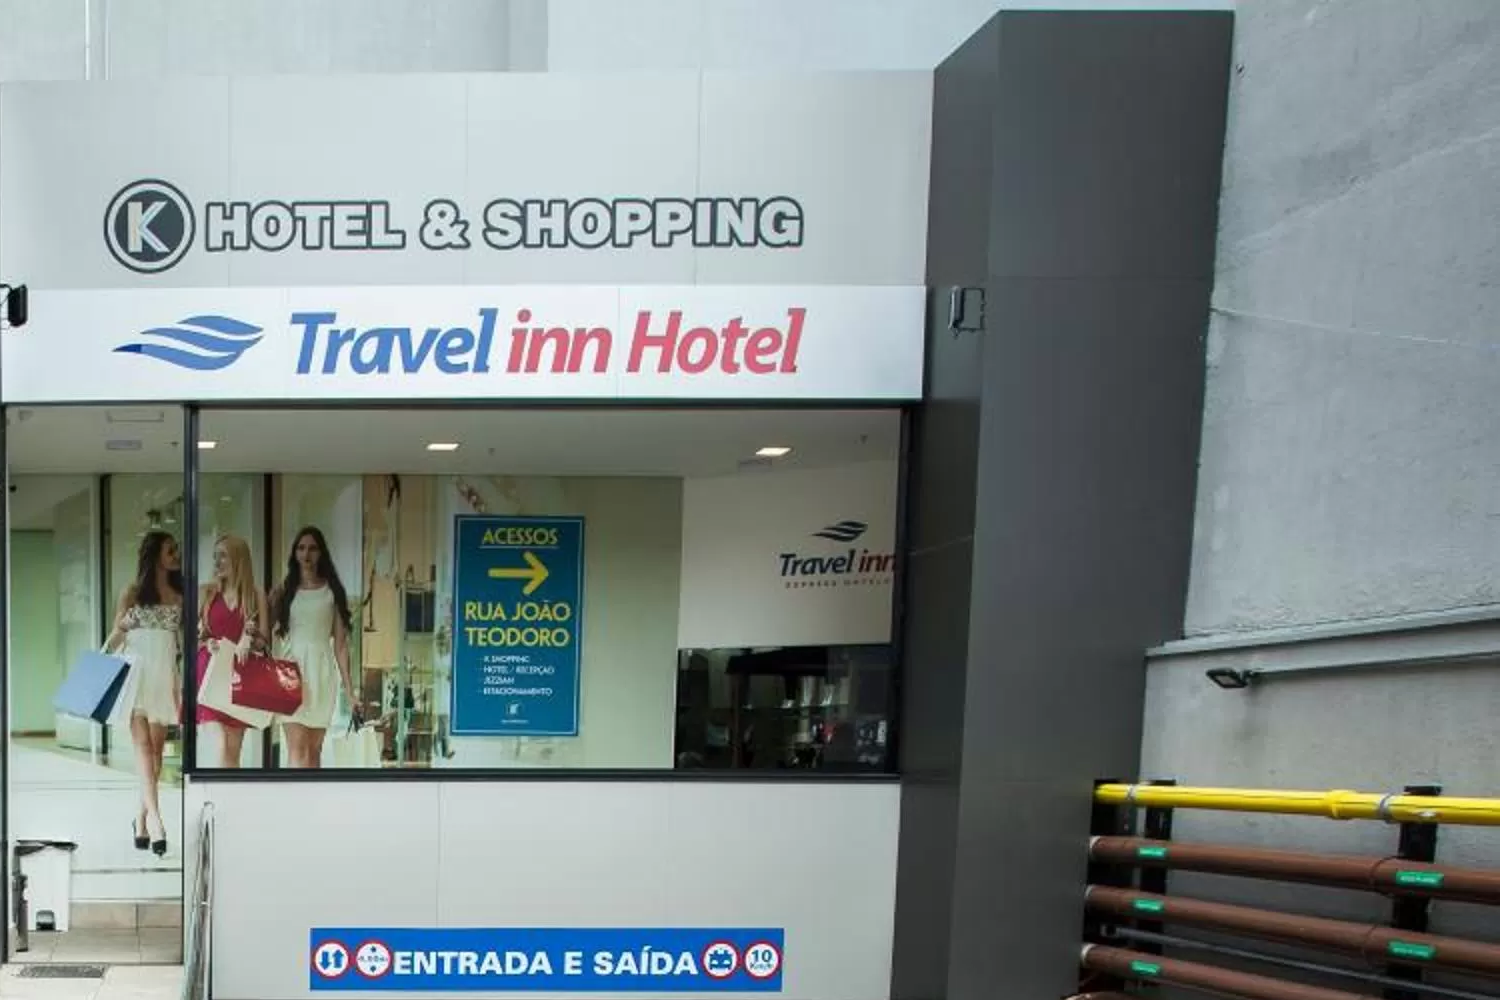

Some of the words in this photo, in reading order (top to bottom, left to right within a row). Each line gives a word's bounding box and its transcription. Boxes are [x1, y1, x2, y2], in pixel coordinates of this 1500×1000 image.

[205, 200, 406, 252] HOTEL
[419, 198, 471, 250] &
[482, 196, 804, 250] SHOPPING
[290, 307, 498, 374] Travel
[506, 309, 613, 373] inn
[626, 307, 806, 374] Hotel
[481, 527, 558, 545] ACESSOS
[780, 548, 856, 577] Travel
[465, 602, 506, 621] RUA
[511, 600, 571, 621] JOÃO
[465, 627, 570, 647] TEODORO
[393, 951, 552, 975] ENTRADA
[564, 951, 582, 975] E
[593, 946, 698, 975] SAÍDA
[751, 949, 773, 963] 10
